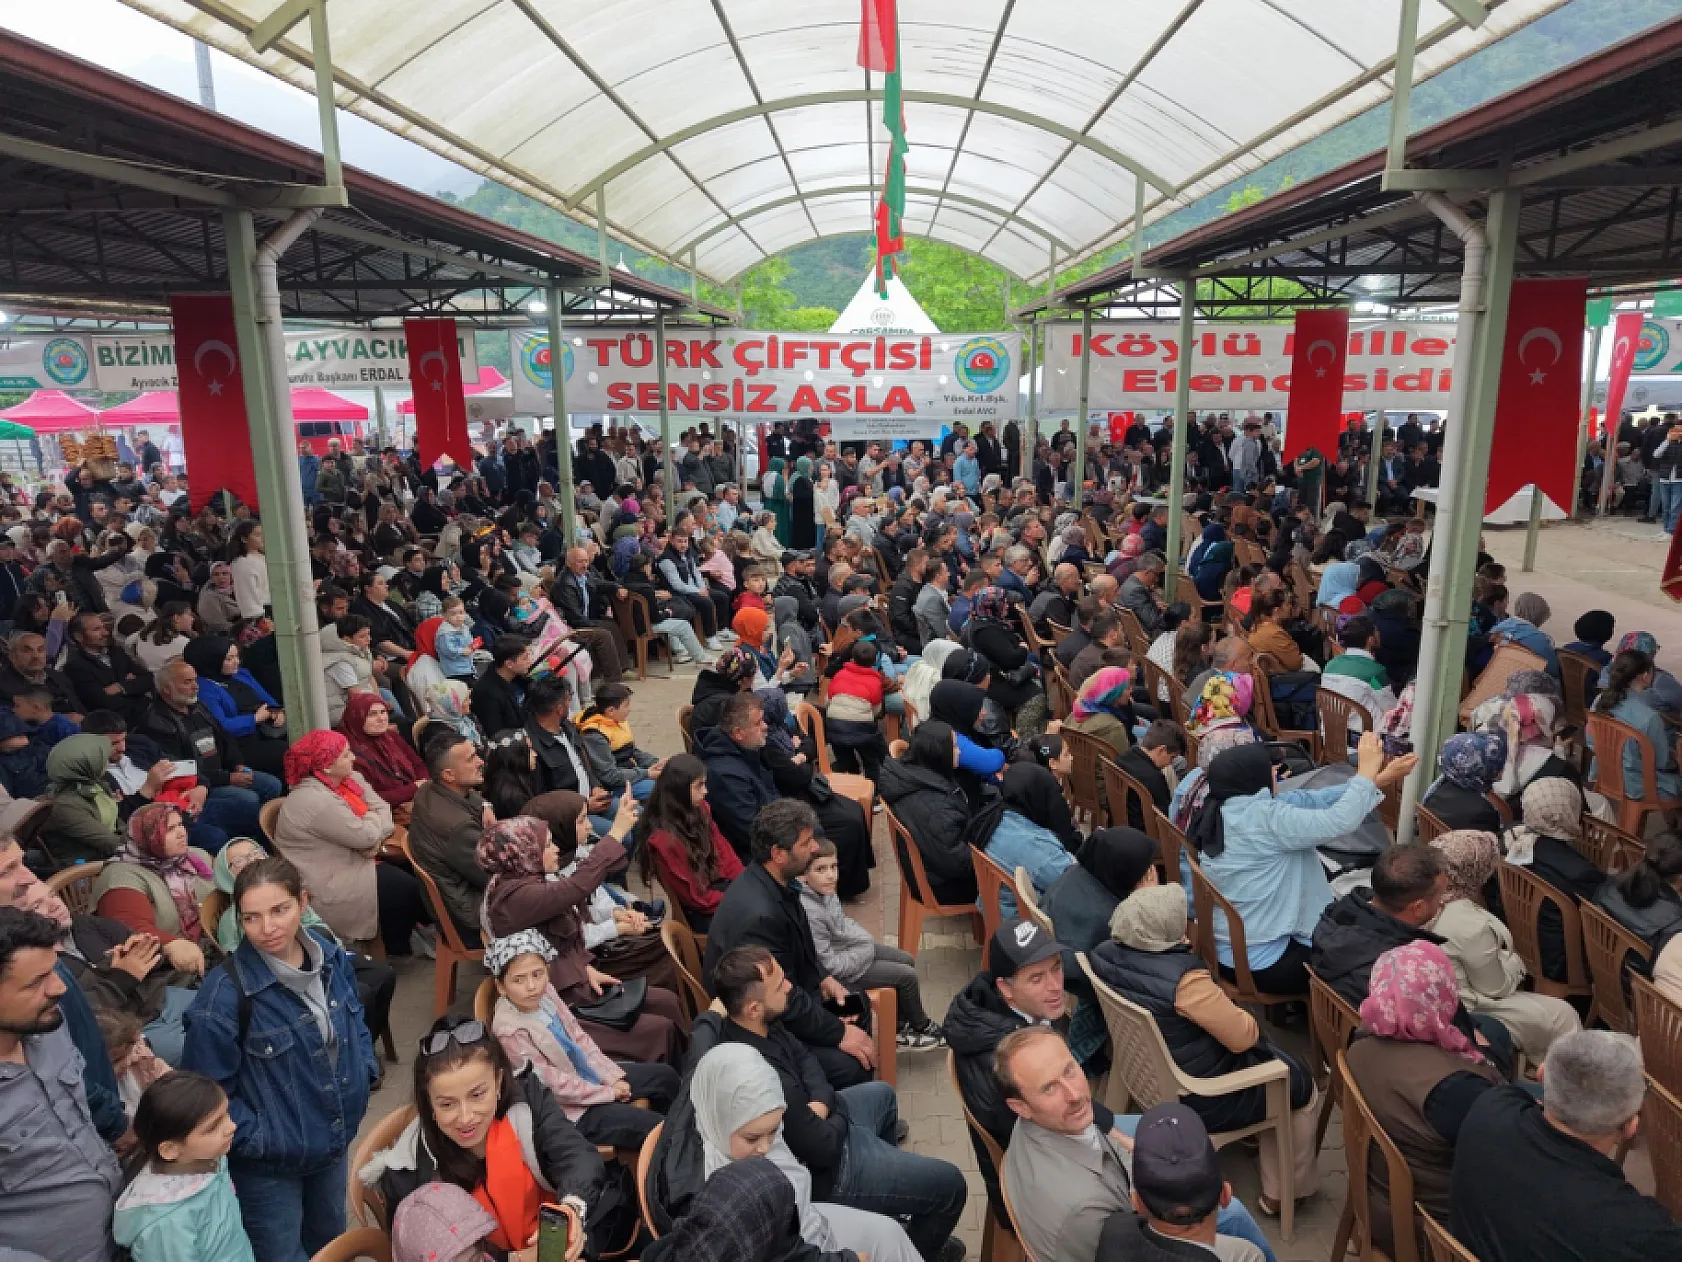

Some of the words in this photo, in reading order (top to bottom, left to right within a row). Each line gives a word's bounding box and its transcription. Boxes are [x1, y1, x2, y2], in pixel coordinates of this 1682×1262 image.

[97, 340, 176, 366] BİZİM
[586, 332, 723, 368] TÜRK
[732, 333, 932, 377] ÇİFTÇİSİ
[1071, 332, 1261, 363] Köylü
[1282, 330, 1456, 356] ille
[360, 368, 404, 381] ERDAL
[606, 378, 778, 412] SENSİZ
[788, 385, 916, 413] ASLA
[976, 407, 996, 415] AVCI
